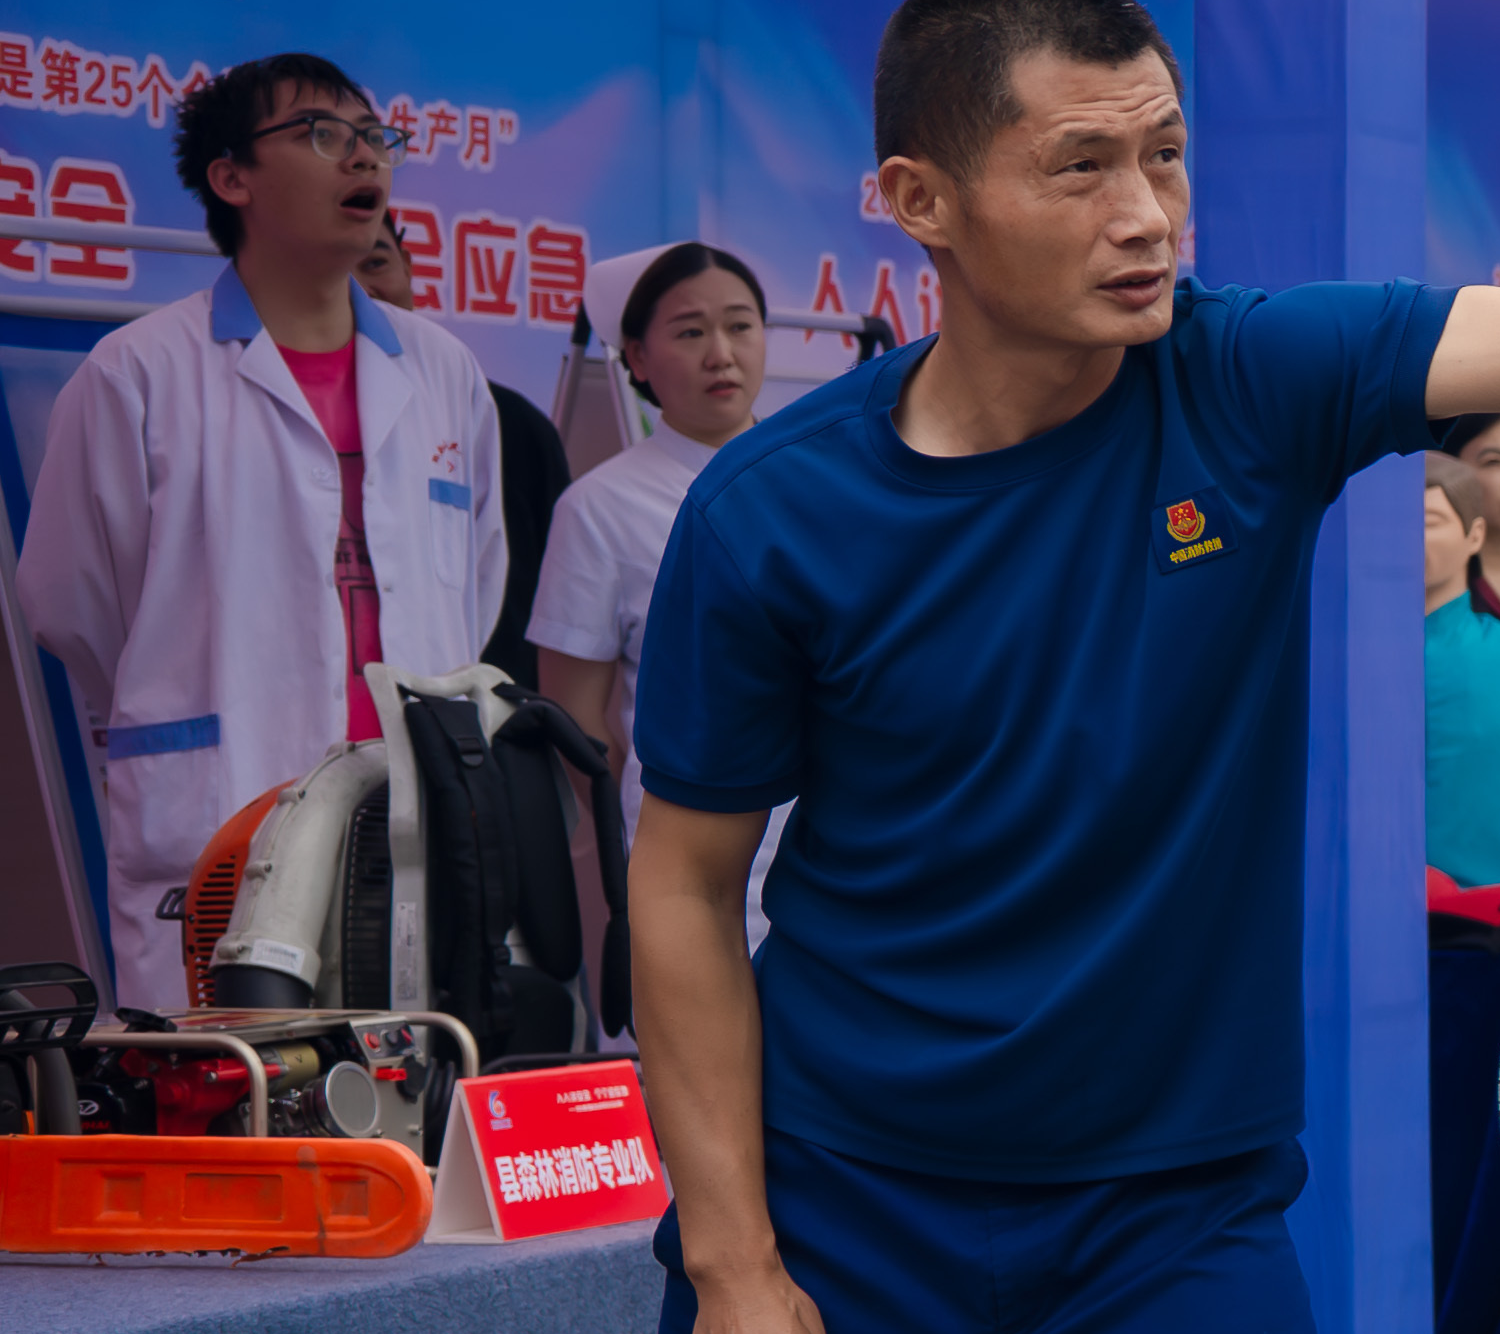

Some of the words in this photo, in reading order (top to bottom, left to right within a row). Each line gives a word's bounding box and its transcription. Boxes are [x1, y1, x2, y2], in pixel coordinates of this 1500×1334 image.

[1169, 536, 1223, 564] 中国消防救援
[494, 1136, 654, 1204] 县森林消防专业队
